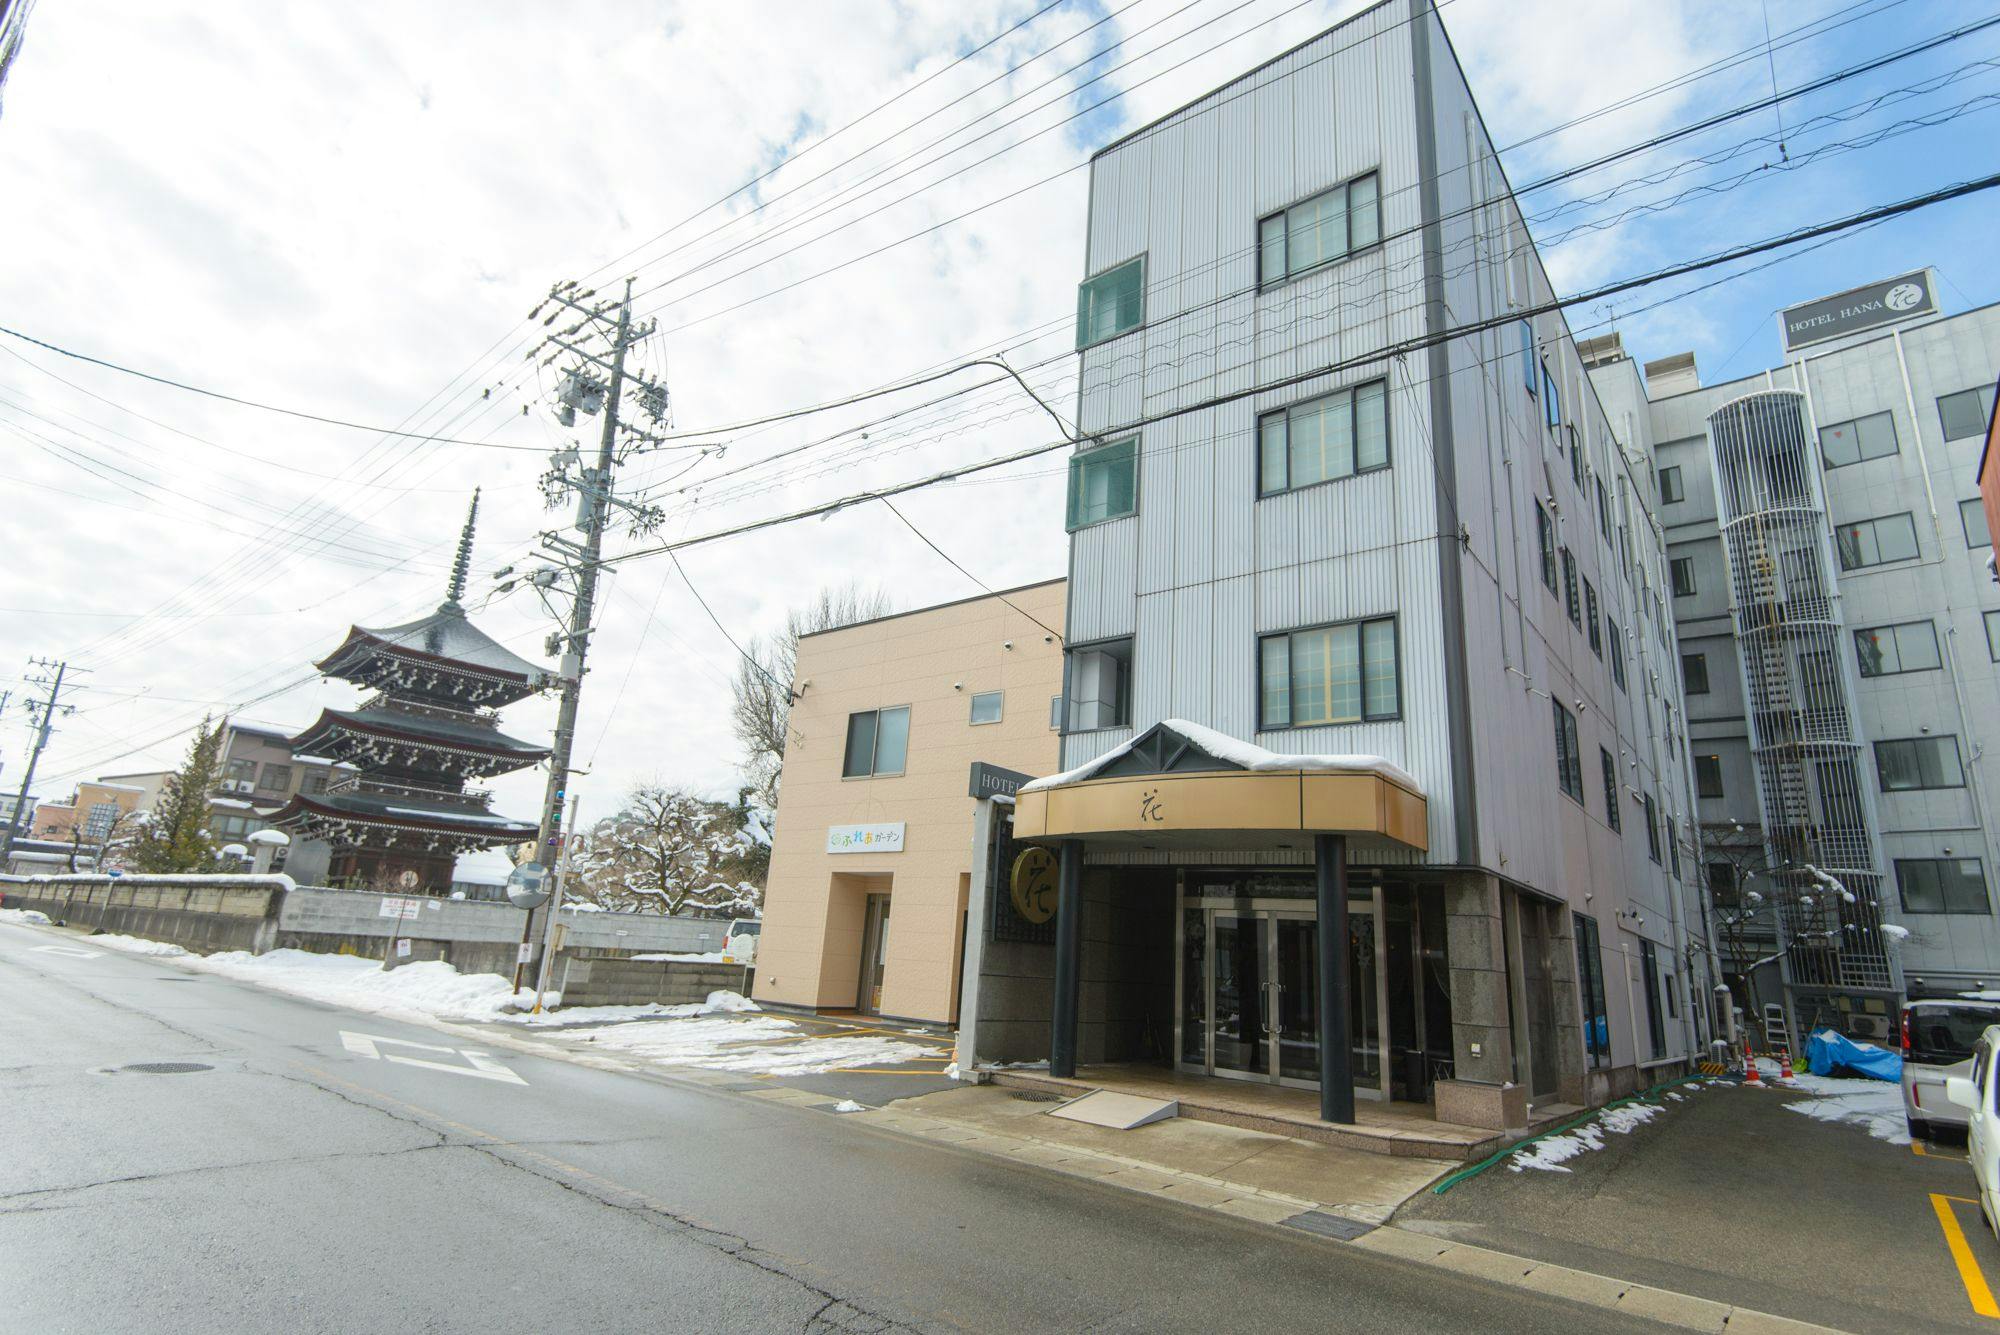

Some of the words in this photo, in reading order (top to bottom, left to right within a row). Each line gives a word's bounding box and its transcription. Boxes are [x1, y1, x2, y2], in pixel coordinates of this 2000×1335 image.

[1790, 313, 1836, 333] HOTEL
[1840, 299, 1883, 319] HANA
[1141, 788, 1164, 822] 花
[1025, 855, 1052, 914] 花
